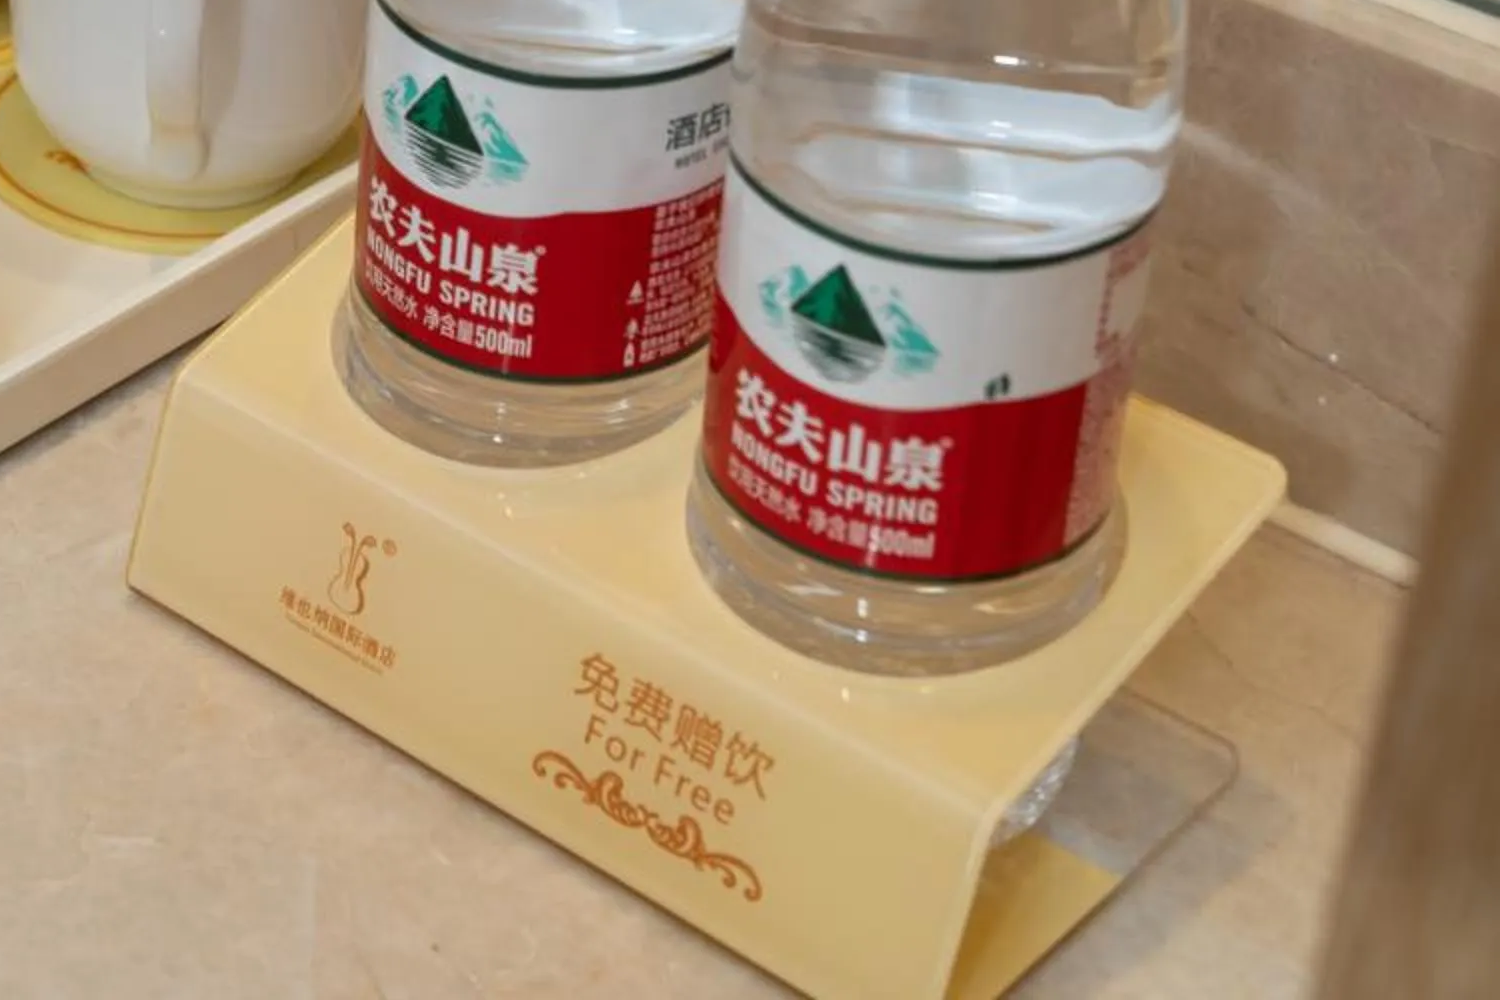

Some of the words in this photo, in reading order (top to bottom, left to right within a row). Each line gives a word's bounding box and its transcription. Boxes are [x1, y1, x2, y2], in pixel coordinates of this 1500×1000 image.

[665, 101, 730, 152] 酒店
[366, 224, 433, 295] NONGFU
[438, 279, 536, 326] SPRING
[369, 175, 540, 296] 农夫山泉
[730, 419, 819, 497] NONGFU
[824, 477, 939, 525] SPRING
[735, 366, 944, 491] 农夫山泉
[573, 652, 776, 801] 免费赠饮
[584, 713, 647, 771] For
[653, 752, 736, 826] Free
